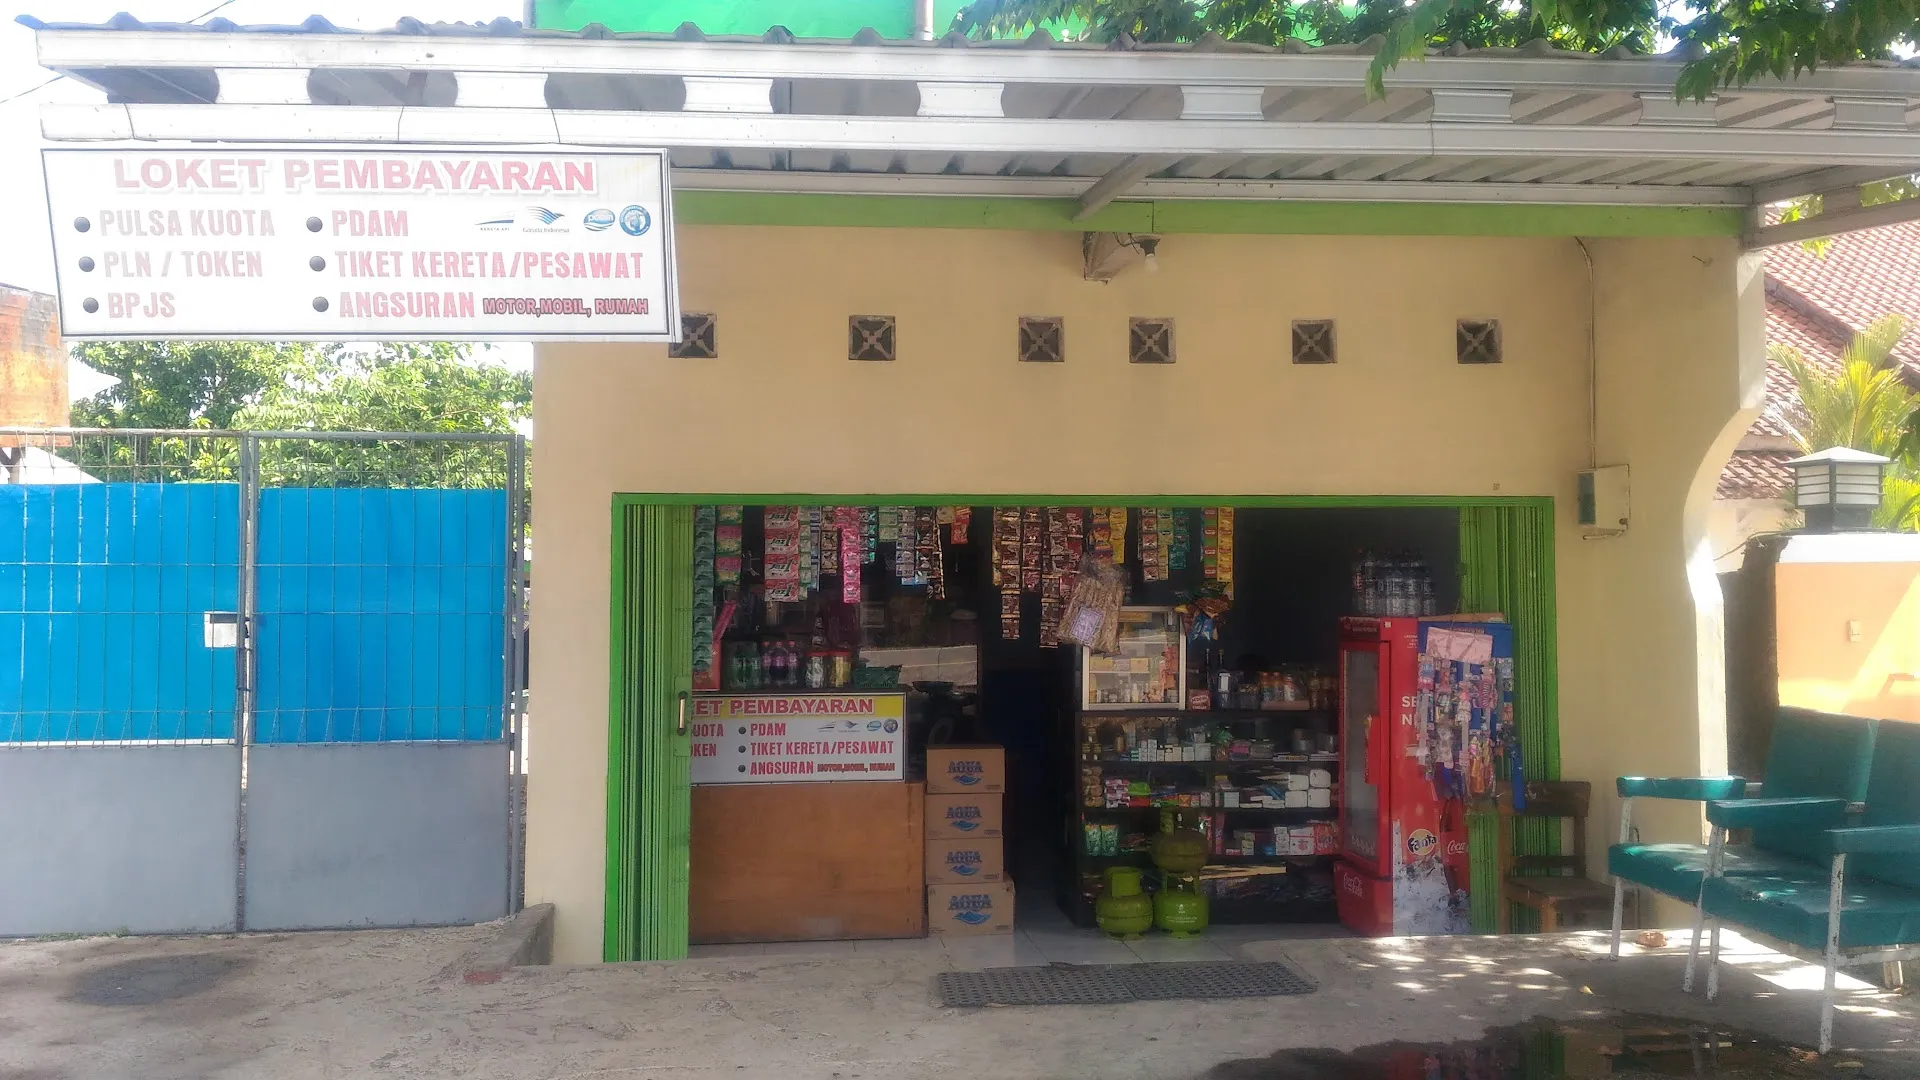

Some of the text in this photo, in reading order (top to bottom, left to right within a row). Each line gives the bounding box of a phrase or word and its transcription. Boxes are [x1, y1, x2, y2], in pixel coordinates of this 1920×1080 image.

[113, 158, 594, 191] LOKET PEMBAYARAN
[99, 209, 275, 237] PULSA KUOTA
[331, 209, 409, 237] PDAM
[103, 250, 152, 278] PLN
[180, 250, 263, 278] TOKEN
[334, 250, 644, 279] TIKET KERETA/PESAWAT
[107, 291, 176, 319] BPJS
[339, 291, 475, 318] ANGSURAN
[594, 297, 649, 315] RUMAH
[692, 699, 873, 715] ET PEMBAYARAN
[750, 722, 786, 737] PDAM
[691, 740, 894, 757] KEN TIKET KERETA/PESAWAT
[750, 761, 814, 775] ANGSURAN
[947, 761, 983, 774] AQUA
[946, 806, 982, 820] AQUA
[1407, 834, 1437, 853] Fanta
[946, 850, 982, 865] AQUA
[948, 895, 993, 911] AQUA
